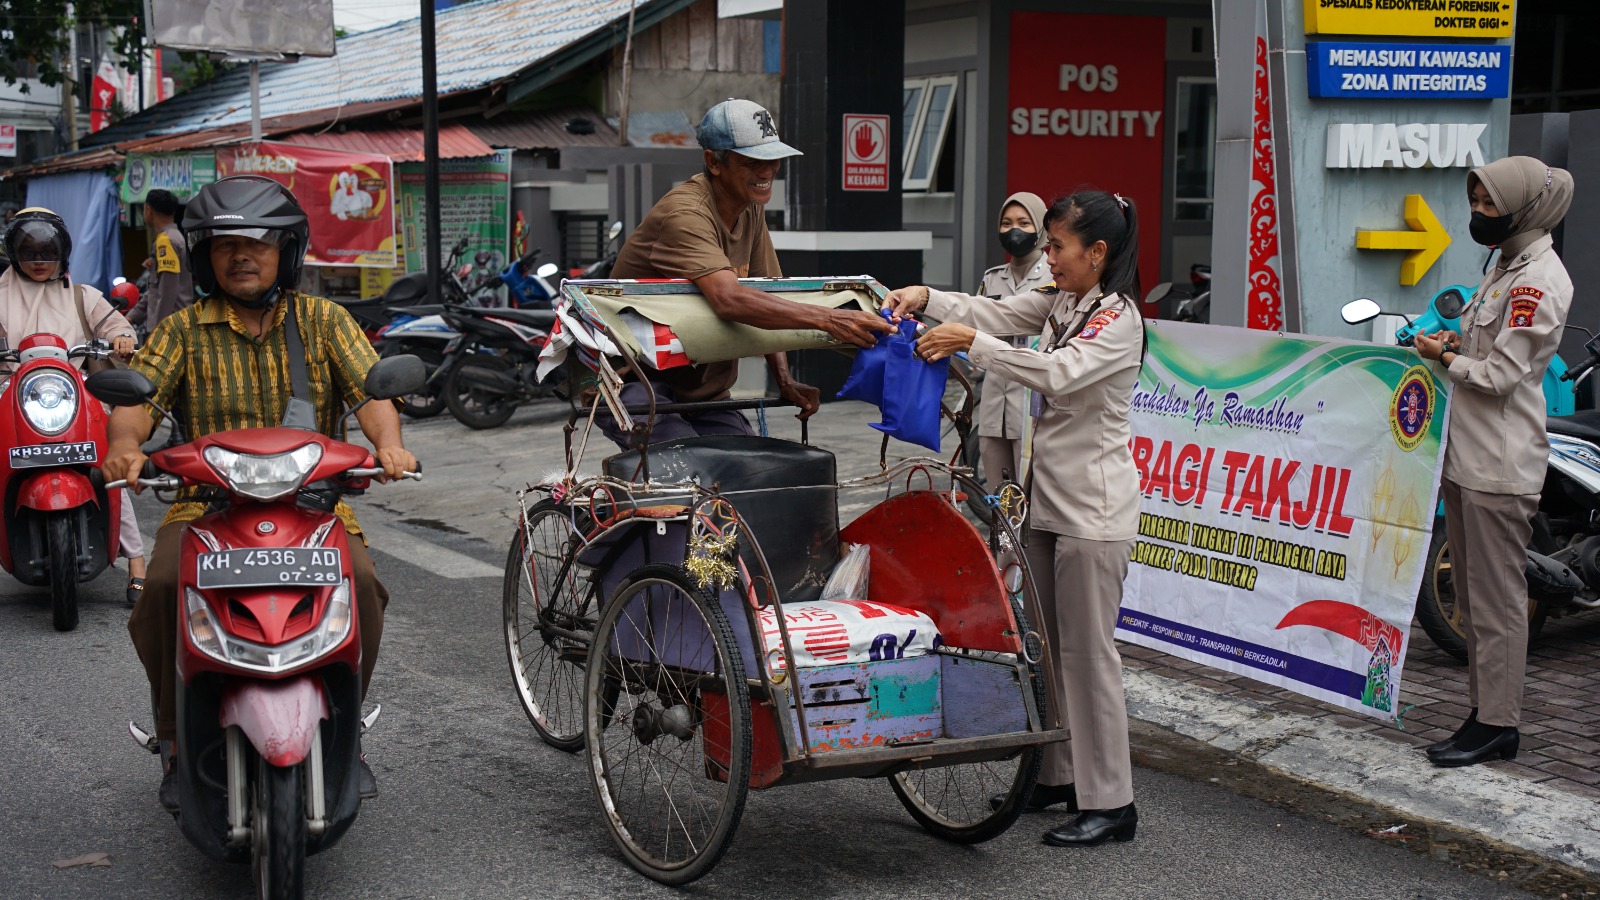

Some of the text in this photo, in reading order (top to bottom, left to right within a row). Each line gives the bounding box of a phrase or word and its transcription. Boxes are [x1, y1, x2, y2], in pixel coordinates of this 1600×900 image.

[1320, 0, 1500, 12] SPESIALIS KEDOKTERAN FORENSIK
[1434, 16, 1500, 29] DOKTER GIGI
[1329, 49, 1501, 68] MEMASUKI KAWASAN
[1058, 63, 1119, 92] POS
[1341, 73, 1487, 92] ZONA INTEGRITAS
[1011, 107, 1162, 137] SECURITY
[1332, 123, 1488, 168] MASUK
[847, 175, 885, 186] KELUAR
[1513, 288, 1541, 297] POLDA
[1194, 386, 1215, 429] Ya
[1220, 391, 1305, 433] Ramadhan
[1129, 436, 1354, 537] BAGI TAKJIL
[202, 550, 336, 570] KH 4536 AD
[1139, 512, 1347, 580] YANGKARA TINGKAT III PALANGKA RAYA
[1174, 549, 1208, 579] POLDA
[1208, 557, 1259, 591] KALTENG
[1122, 615, 1149, 630] PREDIKTIF
[1151, 624, 1196, 644] RESPONSIBILITAS
[1199, 637, 1245, 657] TRANSPARANSI
